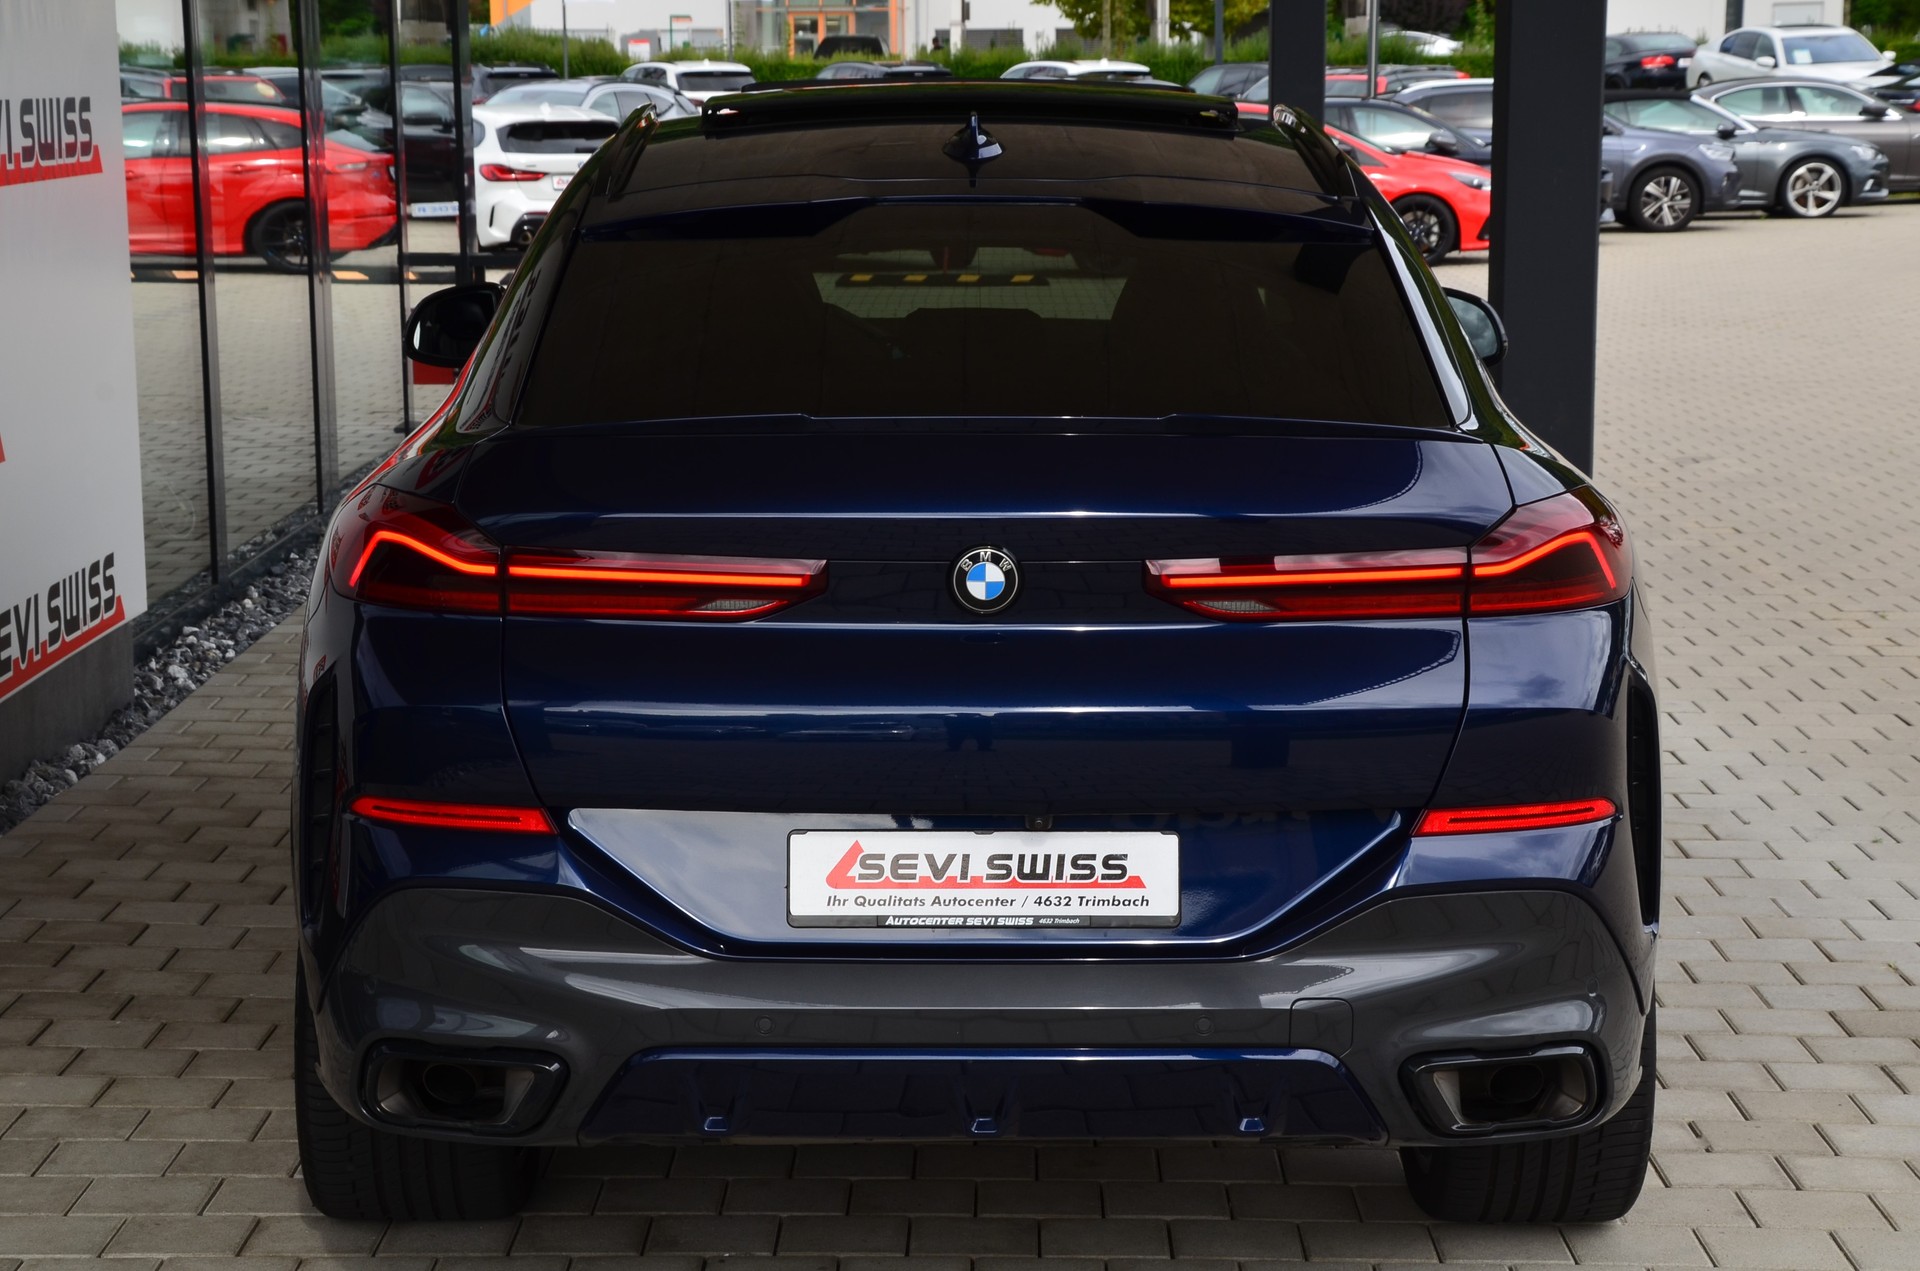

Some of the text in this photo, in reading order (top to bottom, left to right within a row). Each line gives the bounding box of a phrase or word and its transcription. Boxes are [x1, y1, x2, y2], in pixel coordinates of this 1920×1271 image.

[0, 96, 93, 165] I SWISS
[961, 551, 1012, 572] BMW
[47, 552, 116, 649] SWISS
[857, 853, 1129, 881] SEVI SWISS
[827, 895, 1150, 908] Ihr Qualitats Autocenter / 4632 Trimbach
[965, 917, 995, 926] SEVI
[997, 917, 1034, 926] SWISS
